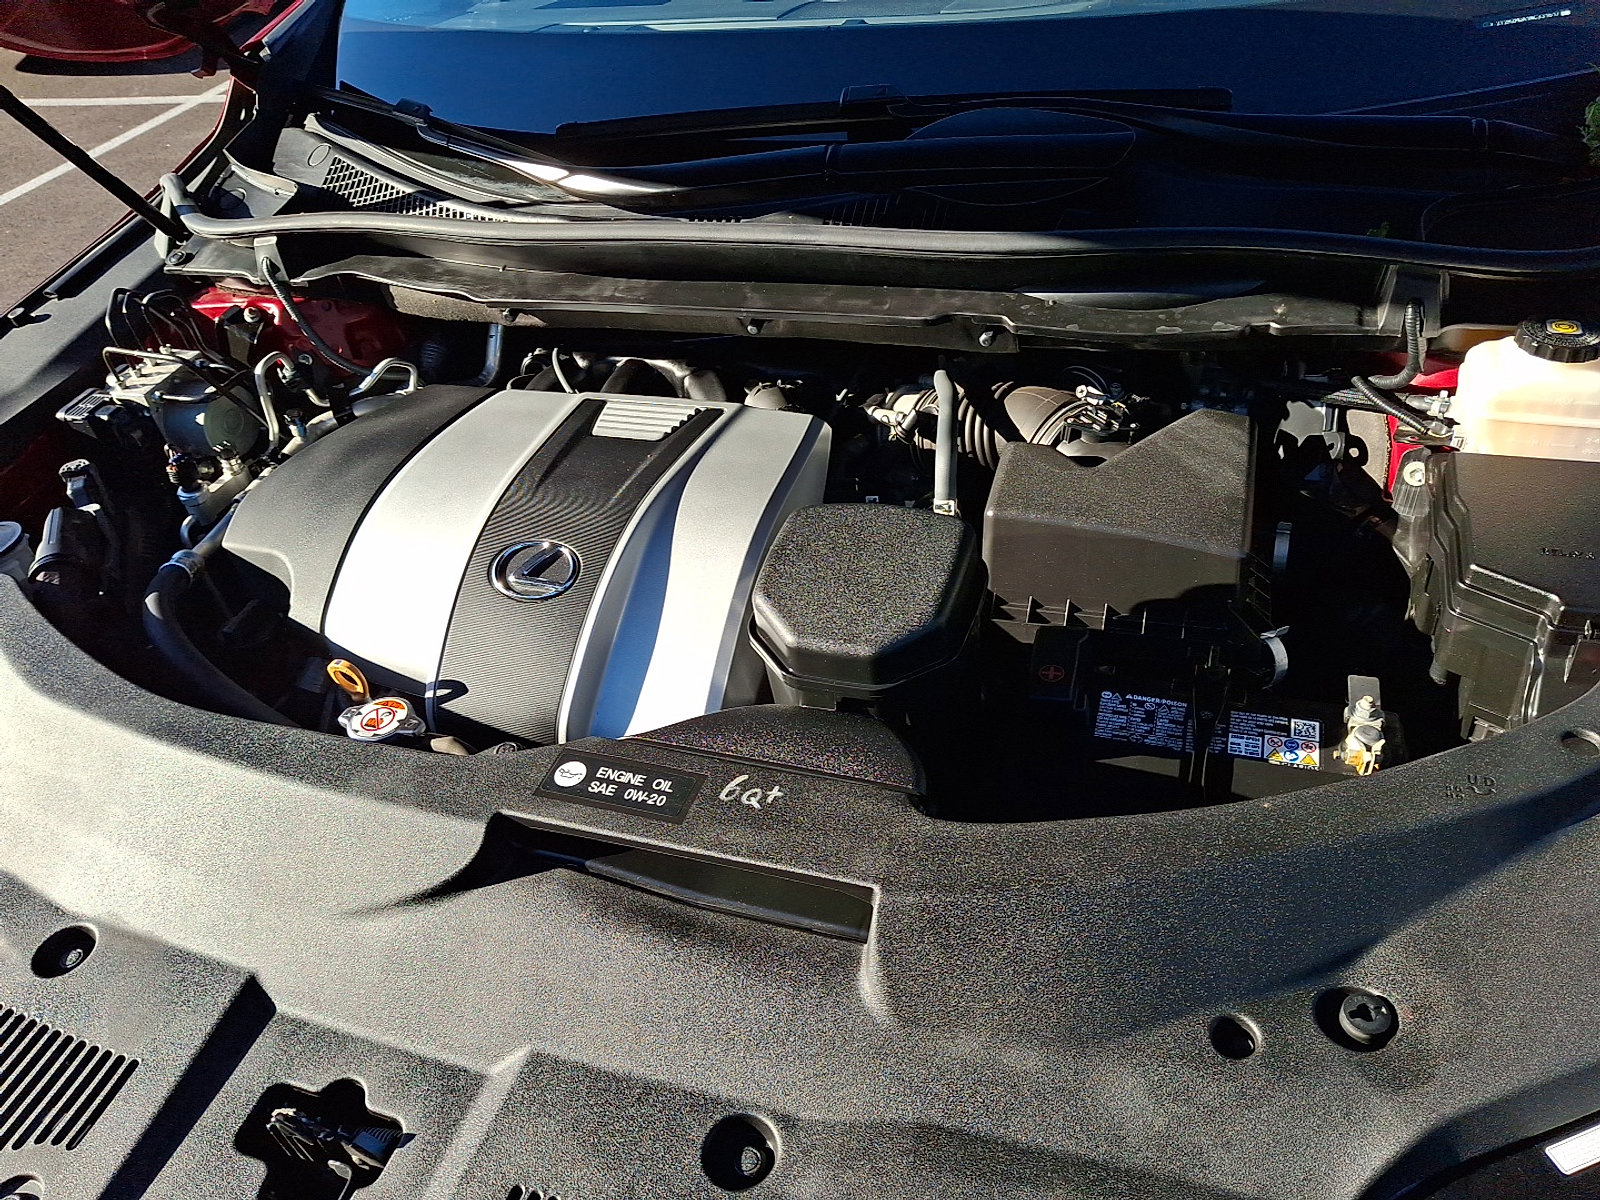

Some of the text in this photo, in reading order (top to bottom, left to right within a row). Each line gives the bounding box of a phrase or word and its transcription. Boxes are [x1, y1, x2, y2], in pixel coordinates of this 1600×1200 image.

[596, 766, 674, 793] ENGINE OIL
[588, 781, 667, 806] SAE 0W-20
